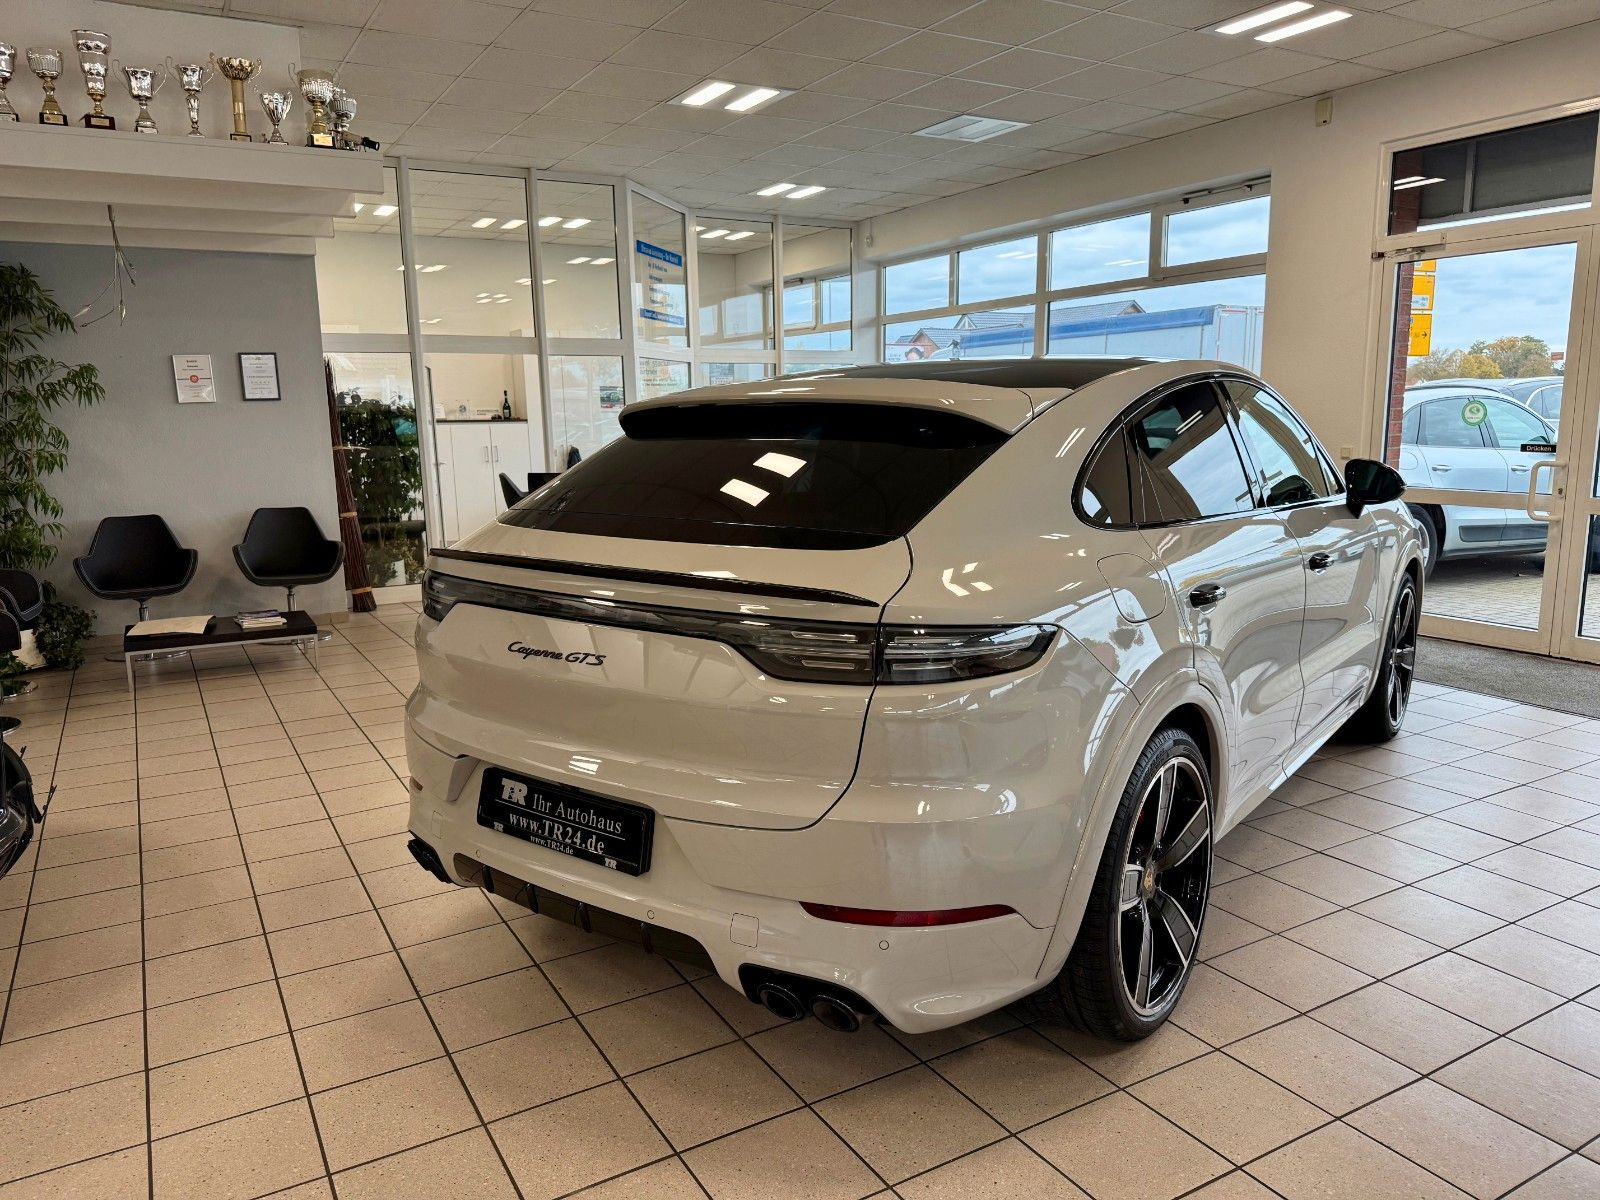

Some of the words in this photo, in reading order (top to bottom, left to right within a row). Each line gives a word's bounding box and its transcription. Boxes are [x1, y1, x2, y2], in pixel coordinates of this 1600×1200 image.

[507, 641, 563, 660] Cayenne
[564, 652, 607, 666] GTS
[532, 793, 552, 813] Ihr
[554, 801, 622, 834] Autohaus
[509, 813, 605, 855] www.TR24.de
[530, 835, 574, 855] www.TR24.de
